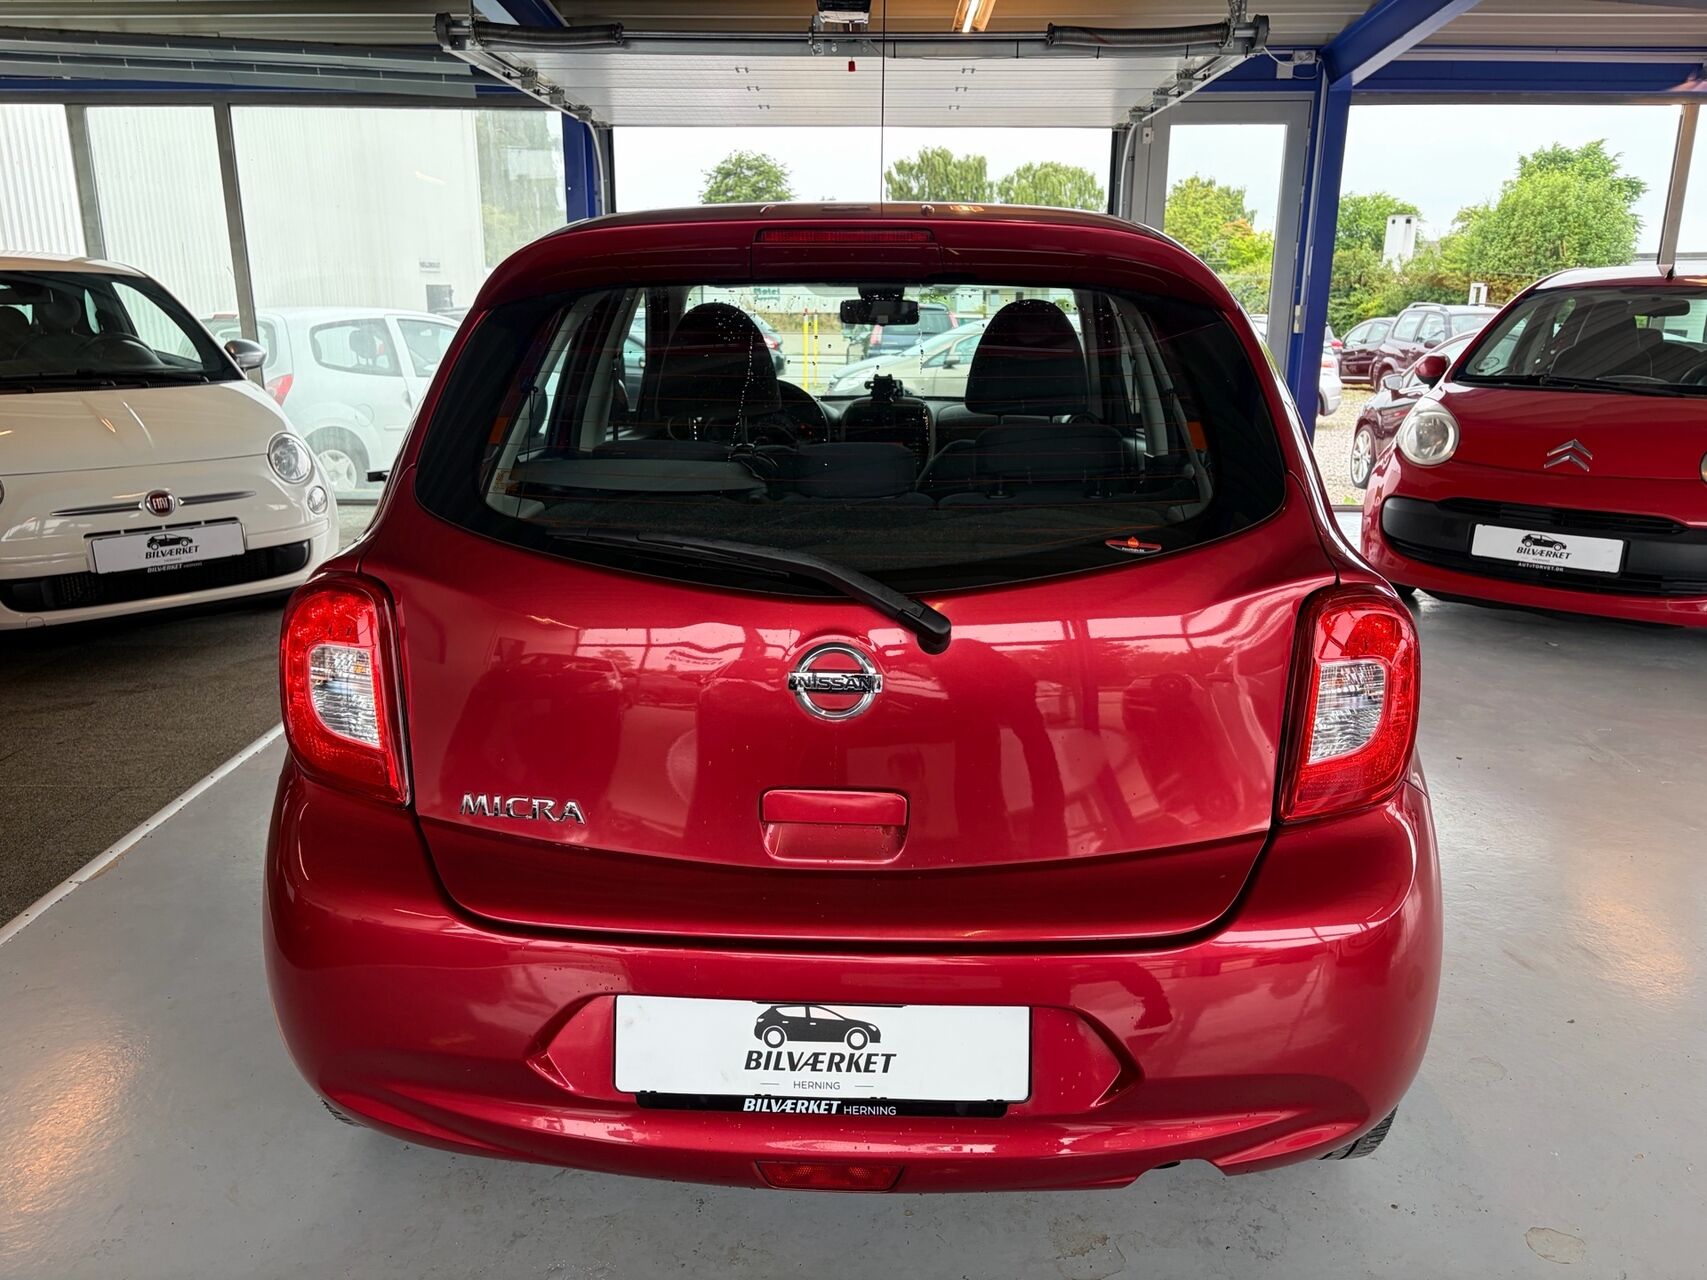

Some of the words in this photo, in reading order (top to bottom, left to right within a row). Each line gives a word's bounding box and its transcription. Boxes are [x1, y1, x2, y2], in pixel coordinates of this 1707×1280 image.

[152, 497, 169, 510] FIAT
[145, 545, 199, 559] BILVÆRKET
[1516, 546, 1572, 560] BILVÆRKET
[797, 673, 875, 692] NISSAN
[460, 791, 586, 825] MICRA
[744, 1050, 897, 1074] BILVÆRKET
[793, 1080, 841, 1091] HERNING
[743, 1097, 841, 1115] BILVÆRKET
[843, 1105, 897, 1116] HERNING
